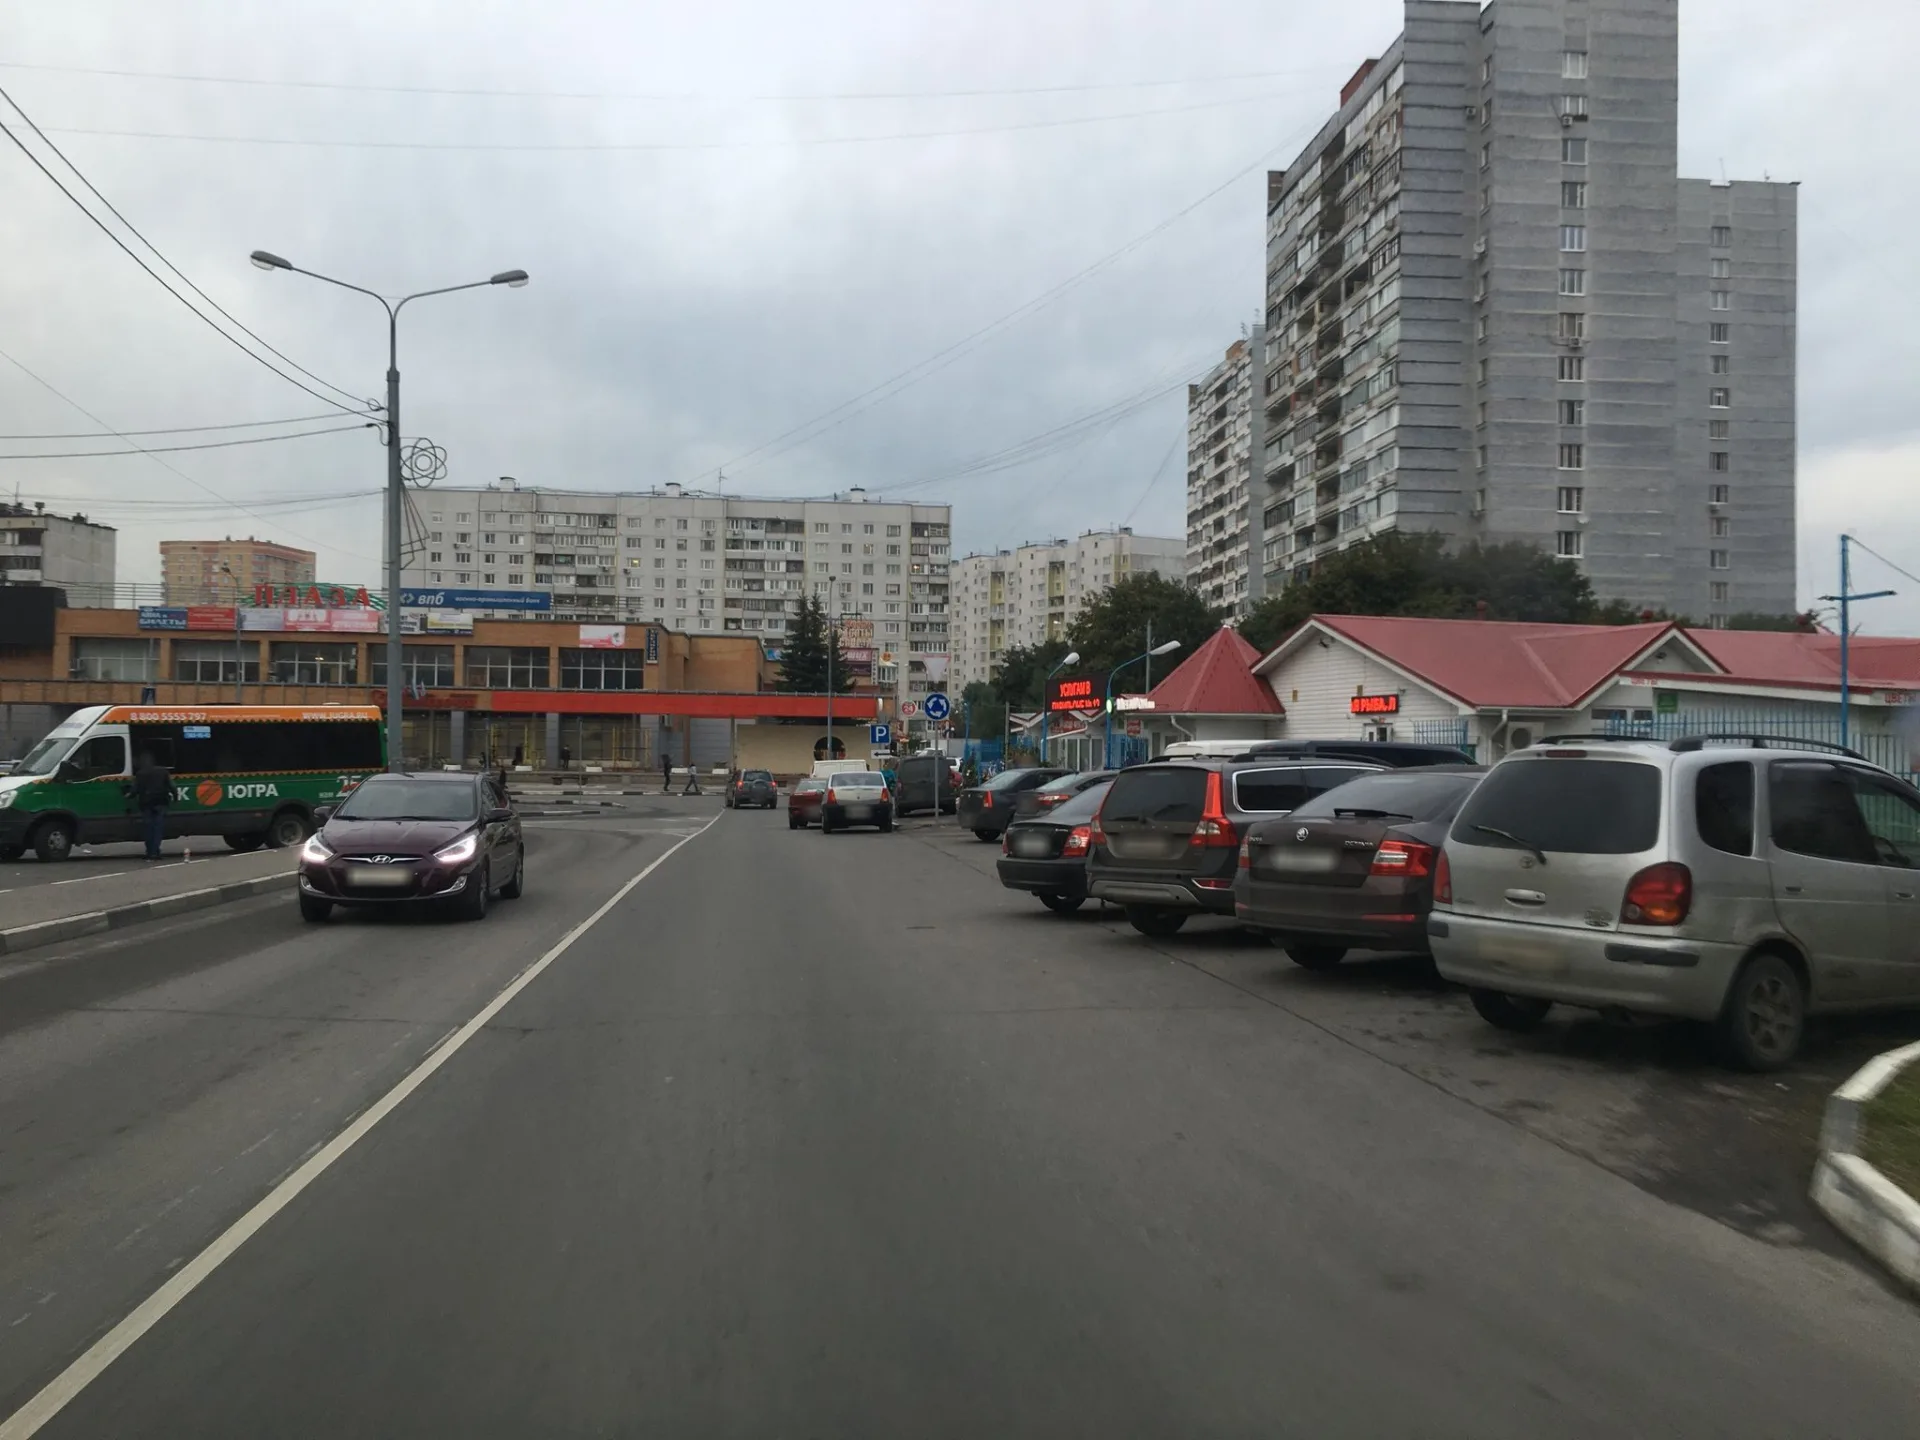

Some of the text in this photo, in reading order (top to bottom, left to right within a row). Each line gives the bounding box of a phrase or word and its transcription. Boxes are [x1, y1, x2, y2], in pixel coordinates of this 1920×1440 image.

[418, 592, 445, 605] впб
[875, 726, 887, 742] P
[228, 784, 279, 799] ЮГРА
